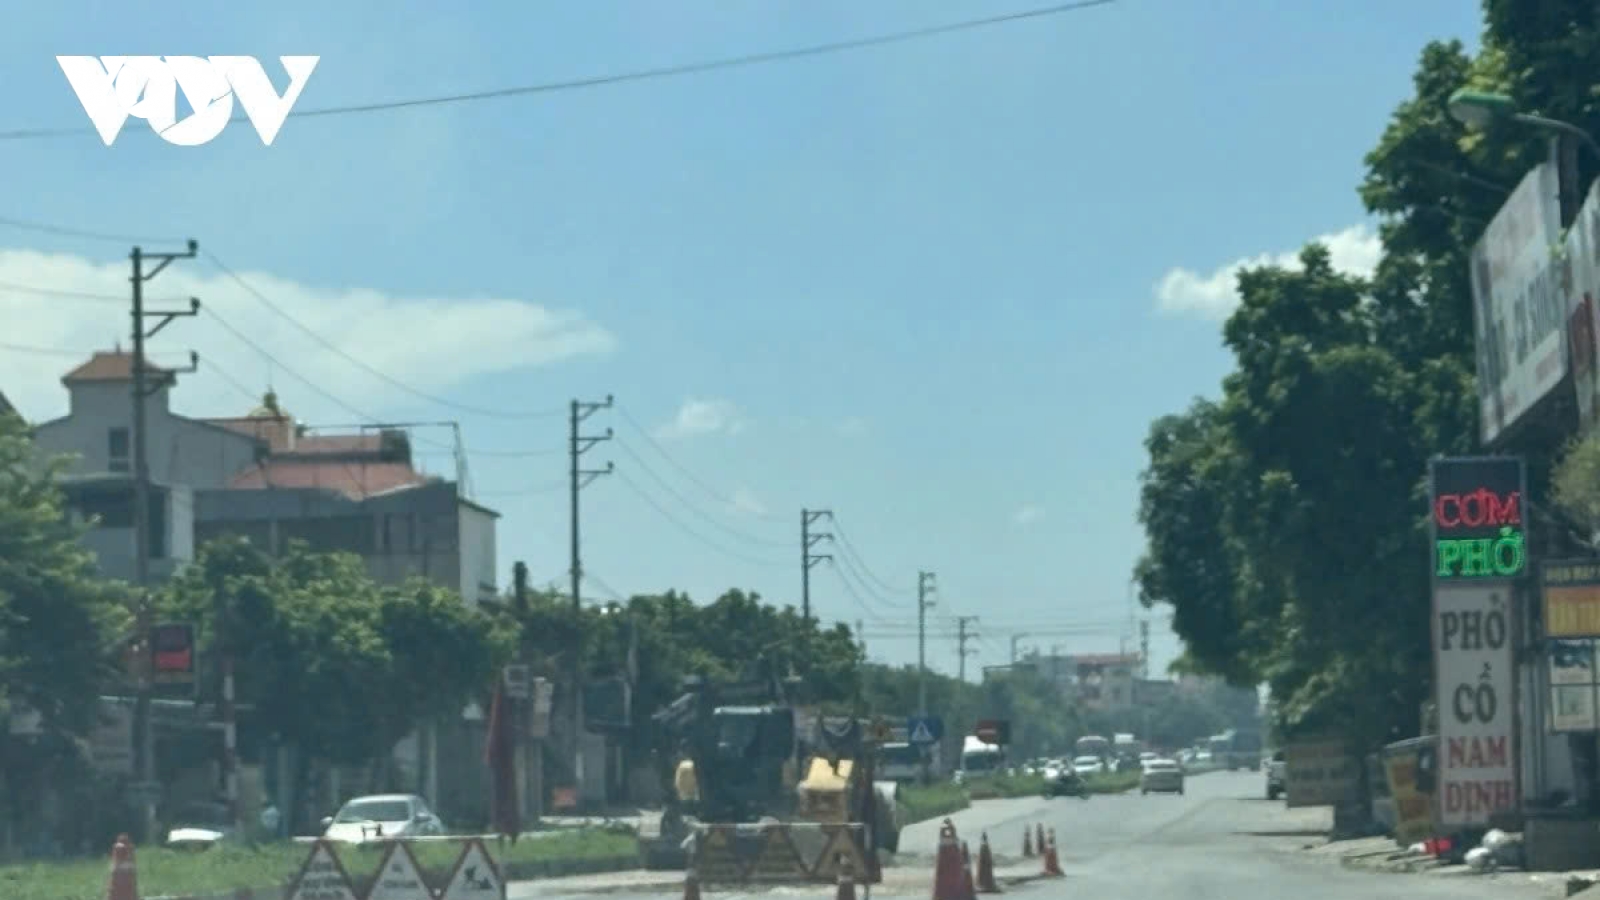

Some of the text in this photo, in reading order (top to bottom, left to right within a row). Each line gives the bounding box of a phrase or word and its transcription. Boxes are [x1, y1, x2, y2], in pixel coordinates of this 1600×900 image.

[1436, 487, 1521, 527] CƠM
[1436, 526, 1525, 577] PHỞ
[1448, 735, 1506, 768] NAM
